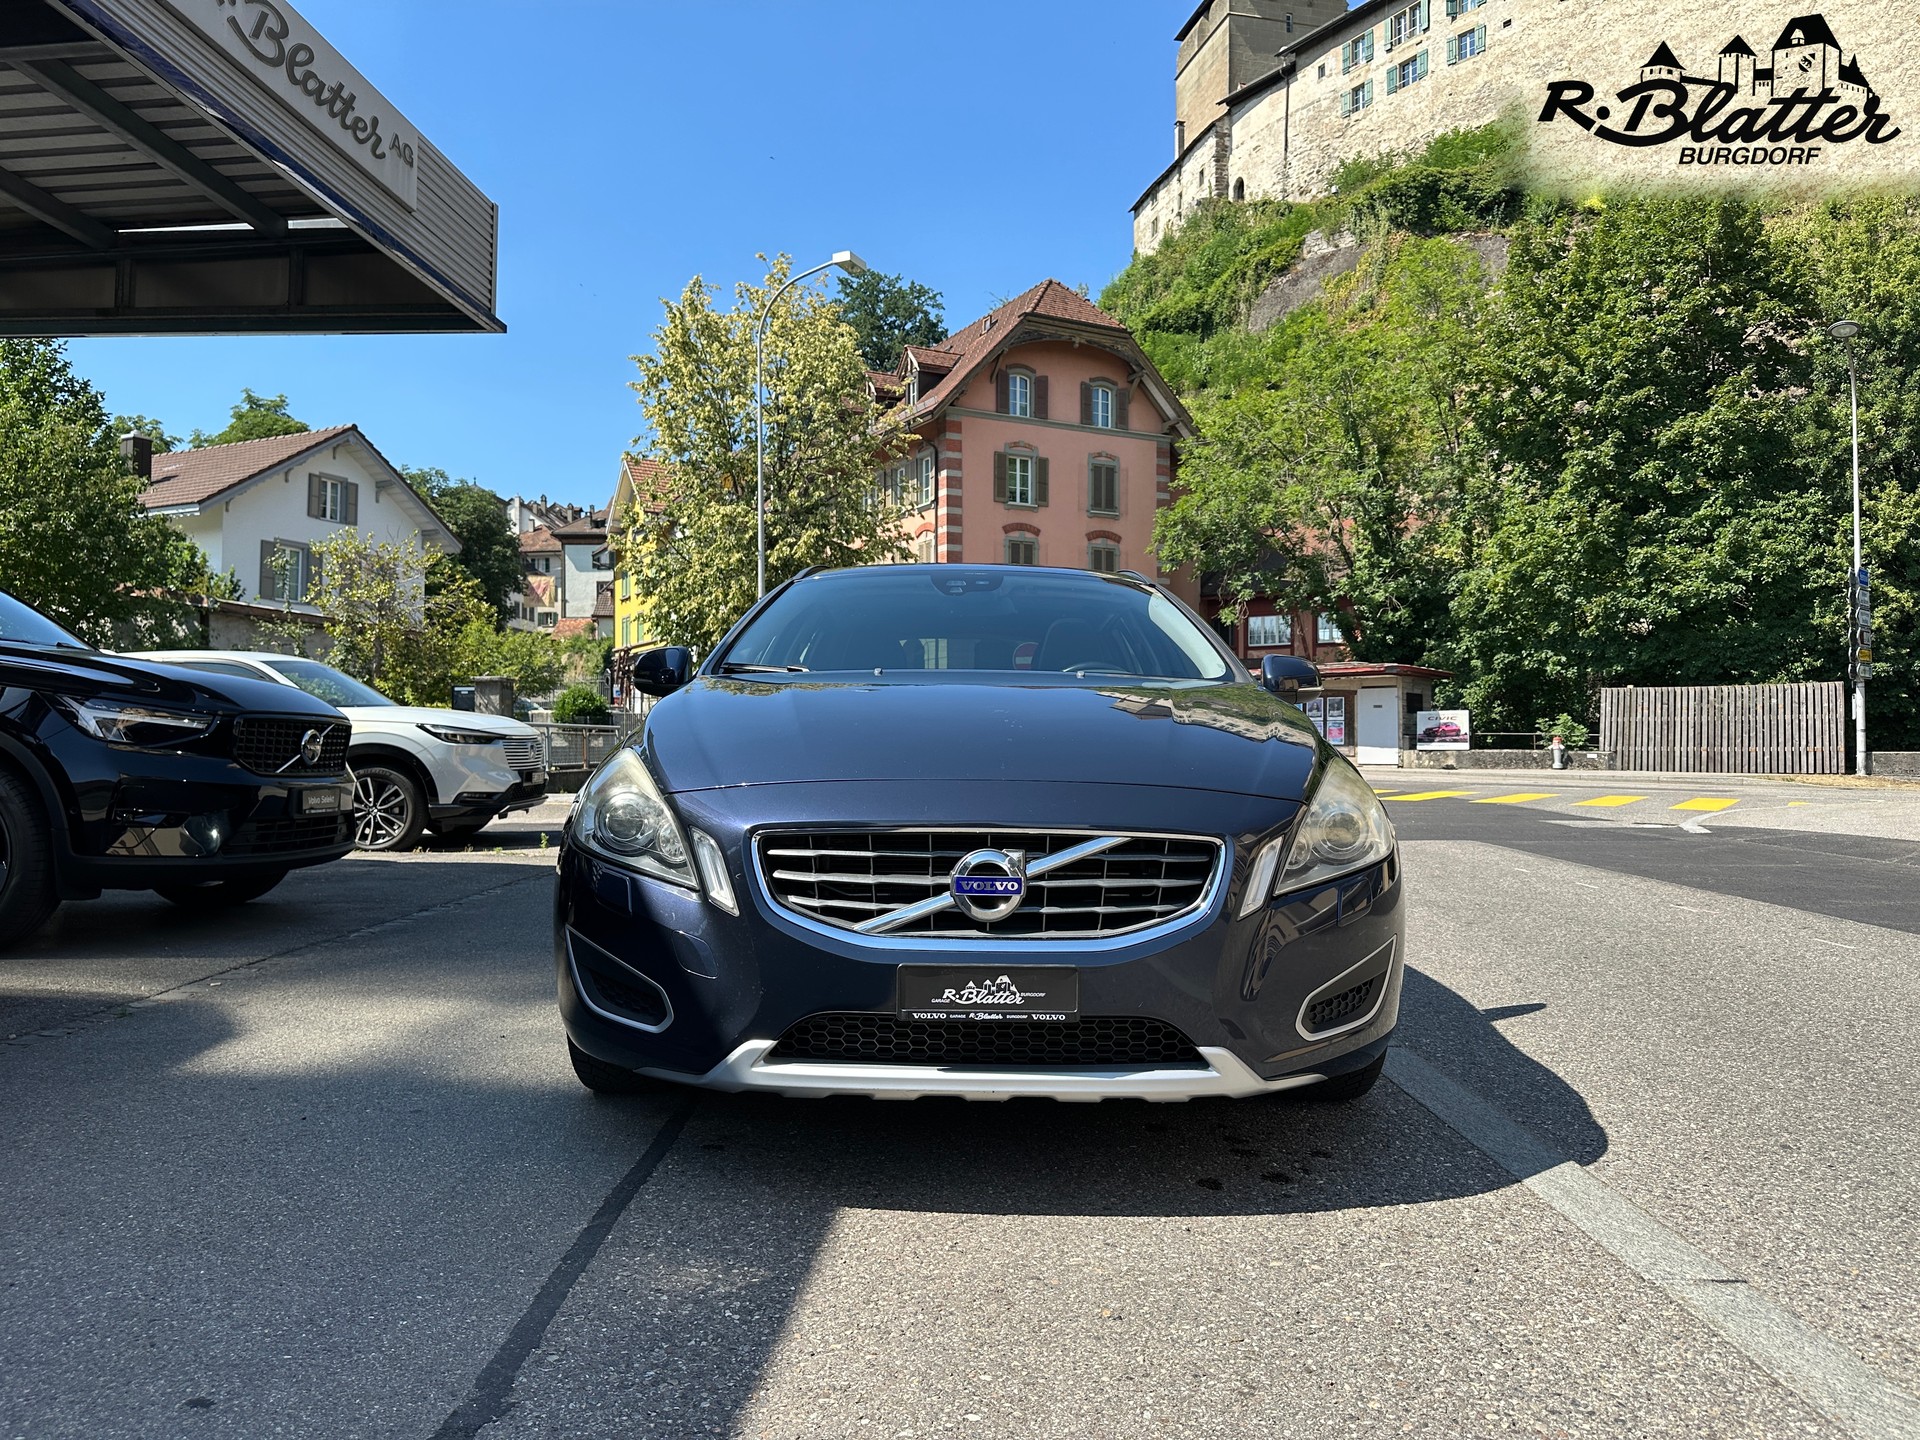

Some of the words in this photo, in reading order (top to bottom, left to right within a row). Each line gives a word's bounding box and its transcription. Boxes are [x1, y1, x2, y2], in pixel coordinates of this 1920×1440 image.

[389, 132, 414, 168] AG
[960, 881, 1019, 891] VOLVO
[912, 1012, 948, 1020] VOLVO
[1031, 1013, 1066, 1021] VOLVO
